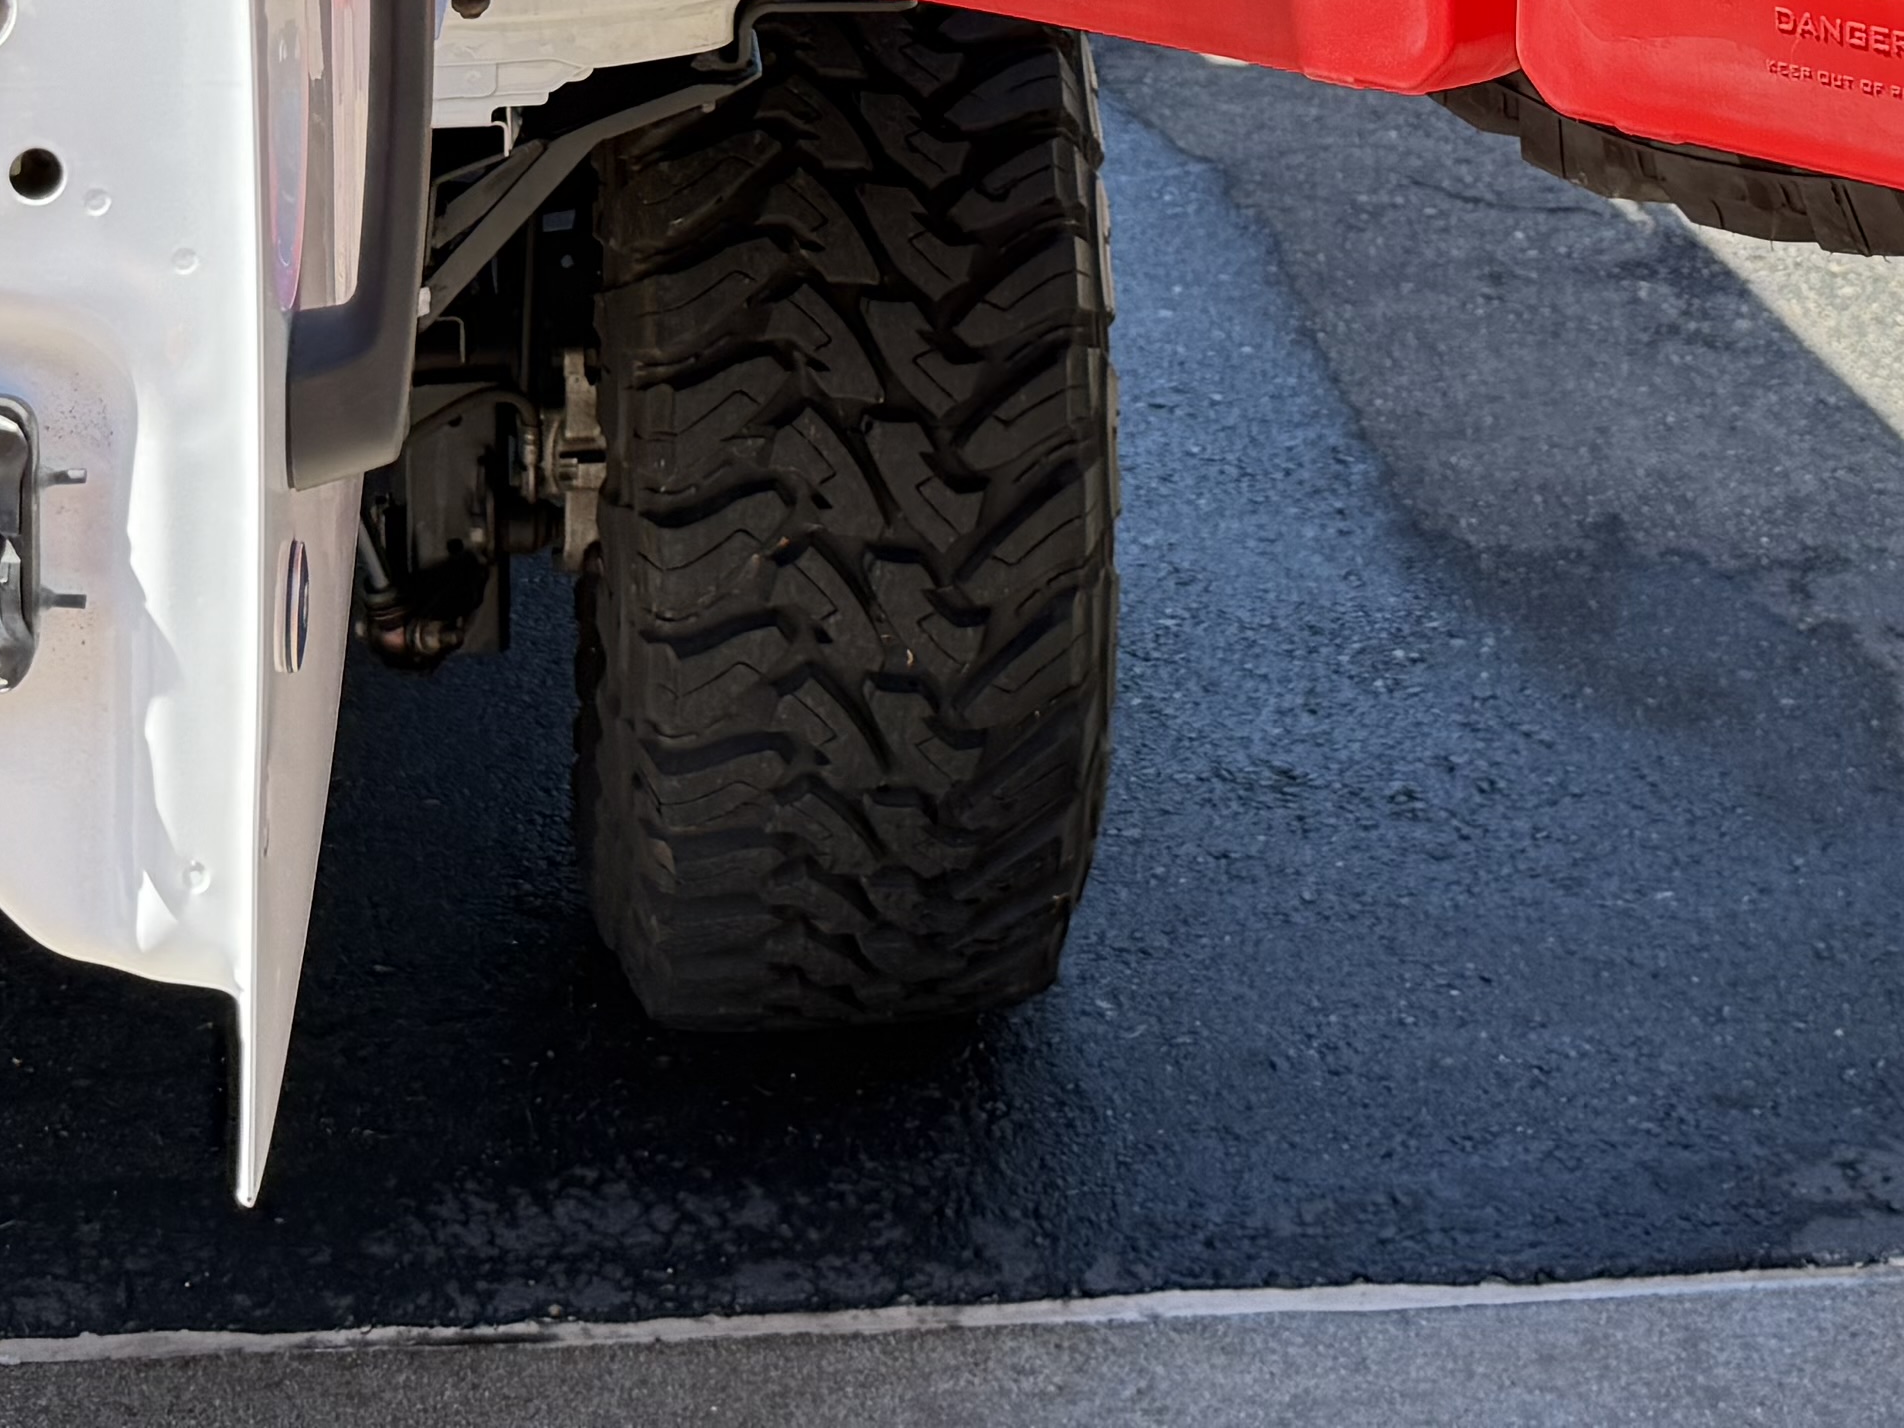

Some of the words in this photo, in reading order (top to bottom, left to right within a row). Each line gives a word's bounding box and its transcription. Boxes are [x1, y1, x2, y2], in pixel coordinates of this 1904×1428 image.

[1766, 59, 1812, 80] KEEP
[1817, 70, 1854, 90] OUT
[1860, 79, 1884, 96] OF
